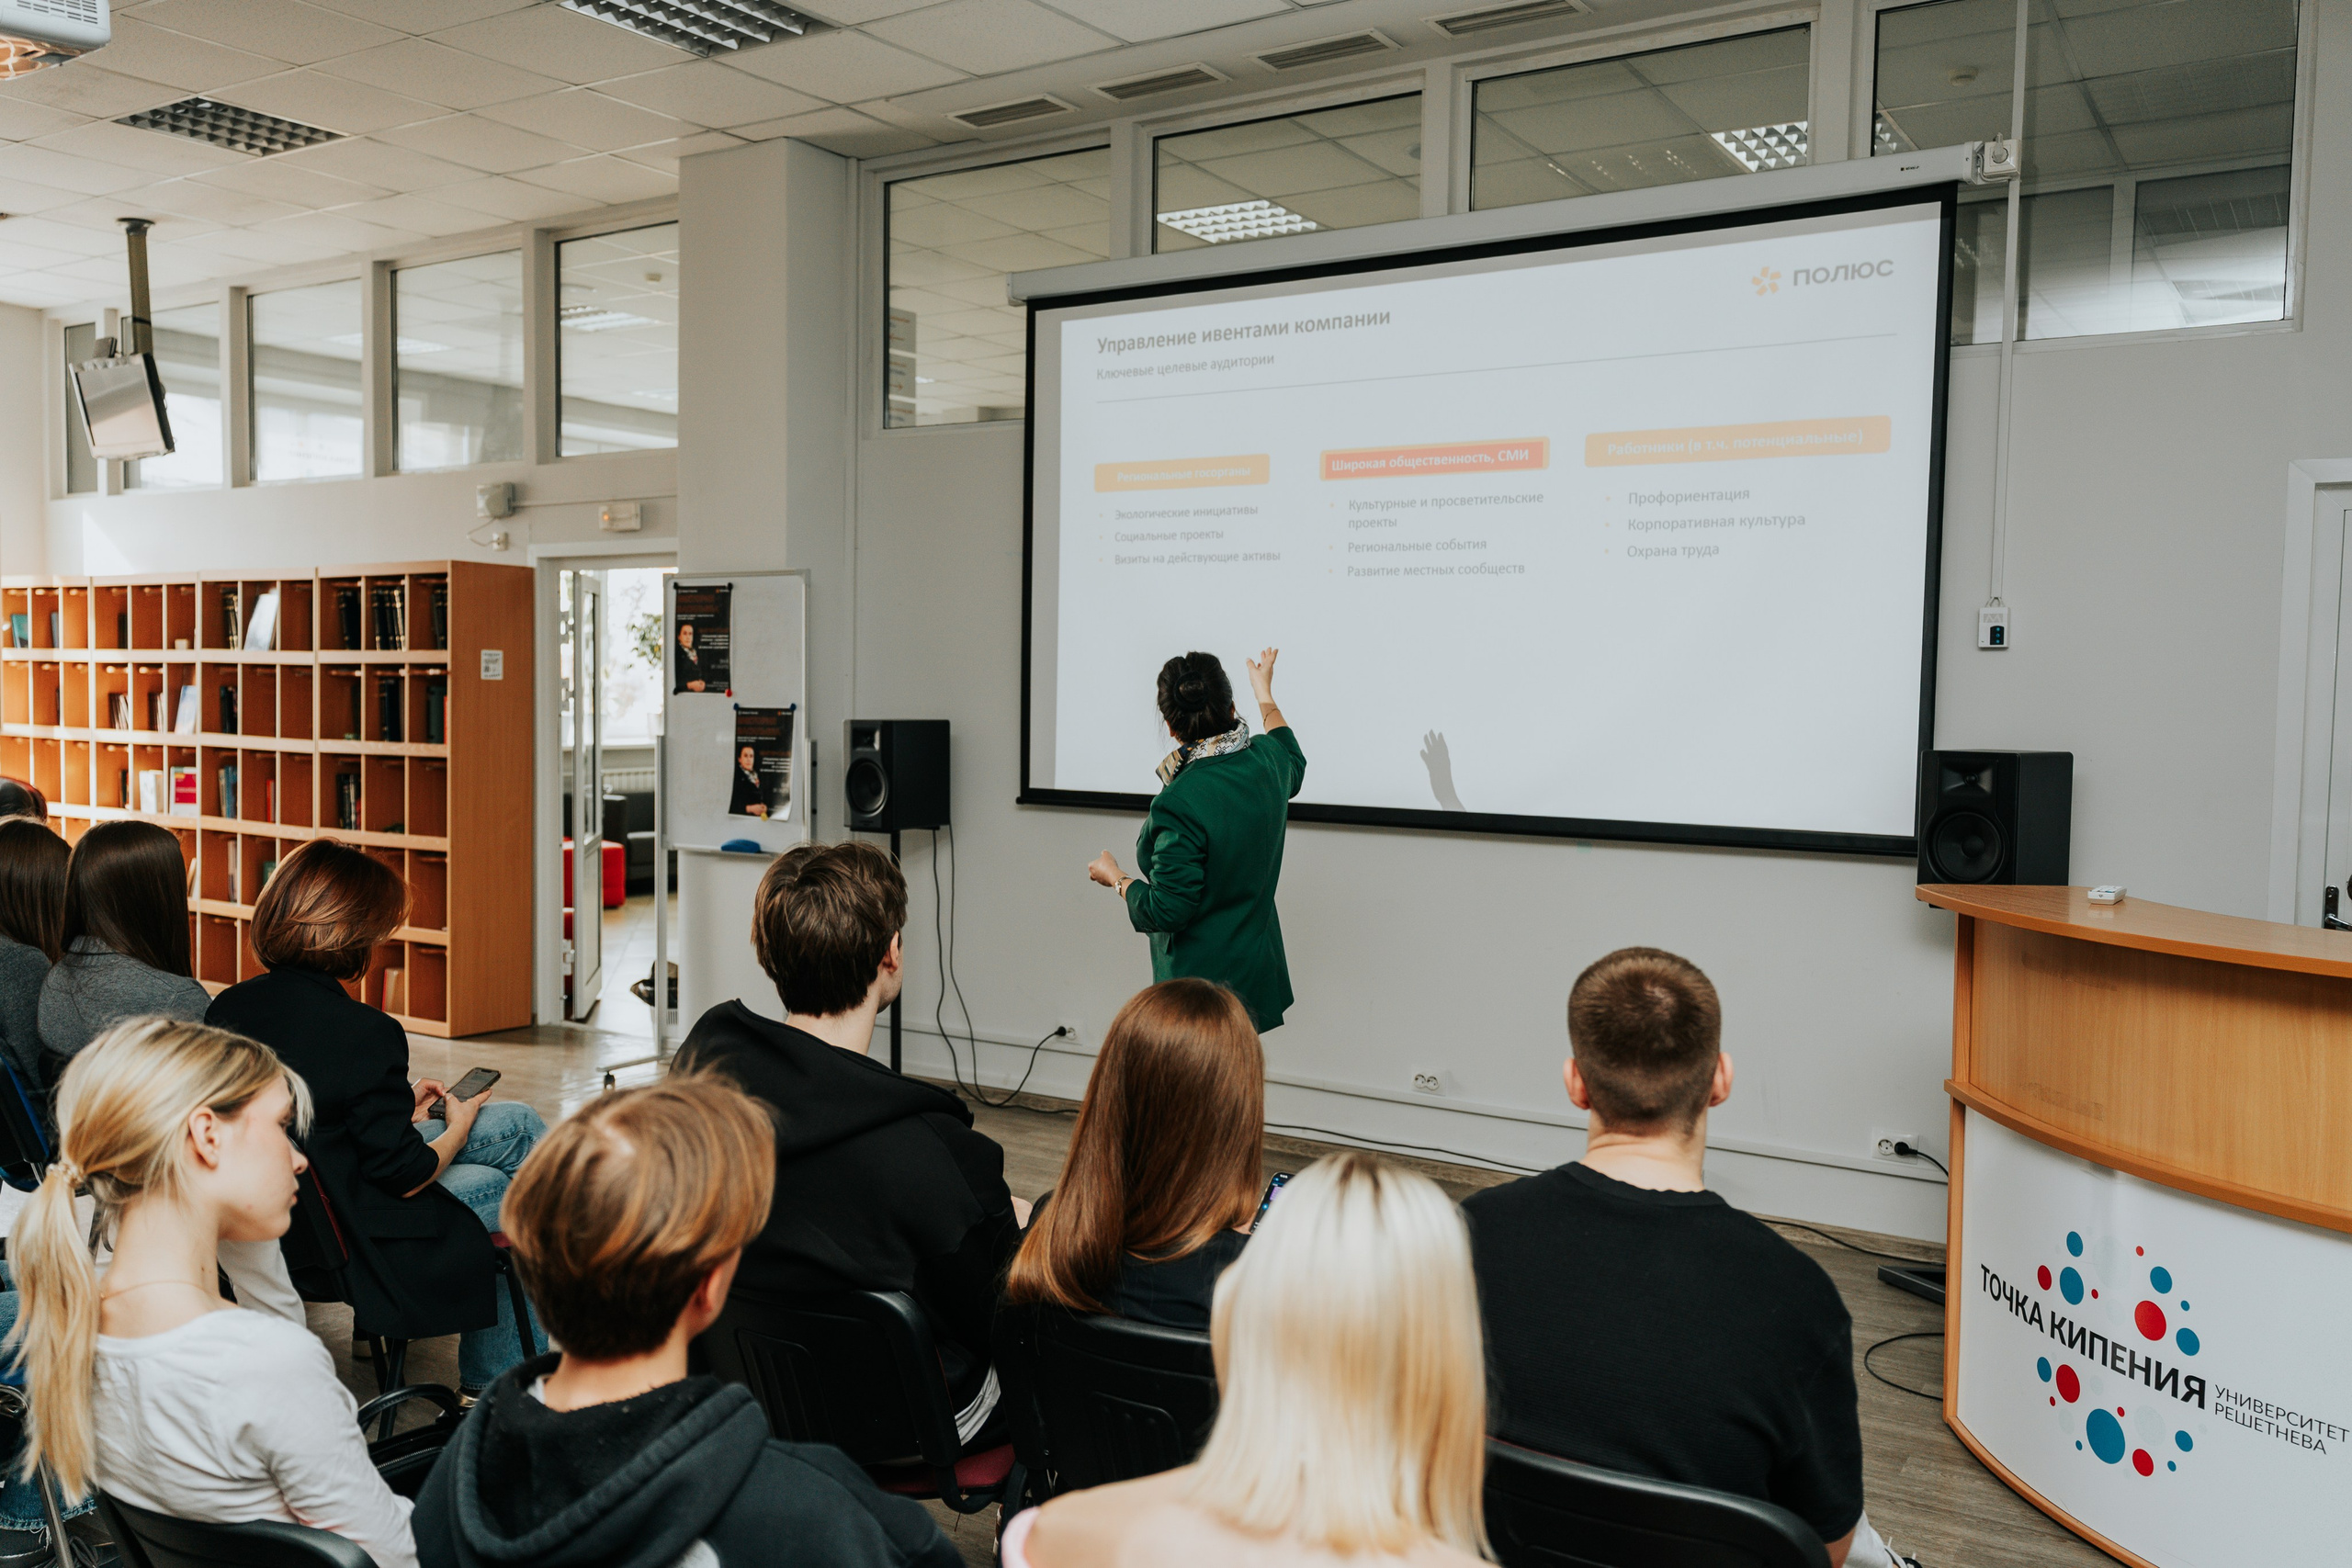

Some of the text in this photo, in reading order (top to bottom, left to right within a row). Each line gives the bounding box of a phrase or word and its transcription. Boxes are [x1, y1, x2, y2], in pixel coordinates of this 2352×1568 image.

[1793, 260, 1893, 285] ПОЛЮС
[1097, 310, 1390, 354] Управление ивентами компании
[1097, 353, 1273, 379] Ключевые целевые аудитории
[1607, 439, 1683, 457] Работники
[1687, 438, 1701, 455] (в
[1732, 428, 1862, 450] потенциальные)
[1331, 448, 1528, 471] Широкая общественность, СМИ
[1194, 466, 1250, 479] госорганы
[1349, 491, 1544, 512] Культурные и просветительские
[1628, 490, 1750, 505] Профориентация
[1114, 503, 1258, 521] Экологические инициативы
[1349, 515, 1396, 530] проекты
[1628, 513, 1805, 532] Корпоративная культура
[1114, 529, 1224, 543] Социальные проекты
[1348, 537, 1487, 554] Региональные события
[1114, 550, 1280, 565] Визиты на действующие активы
[1627, 543, 1719, 558] Охрана труда
[1347, 561, 1524, 579] Развитие местных сообществ
[1981, 1263, 2206, 1410] ТОЧКА КИПЕНИЯ
[2214, 1384, 2350, 1443] УНИВЕРСИТЕТ
[2214, 1402, 2327, 1456] РЕШЕТНЕВА
